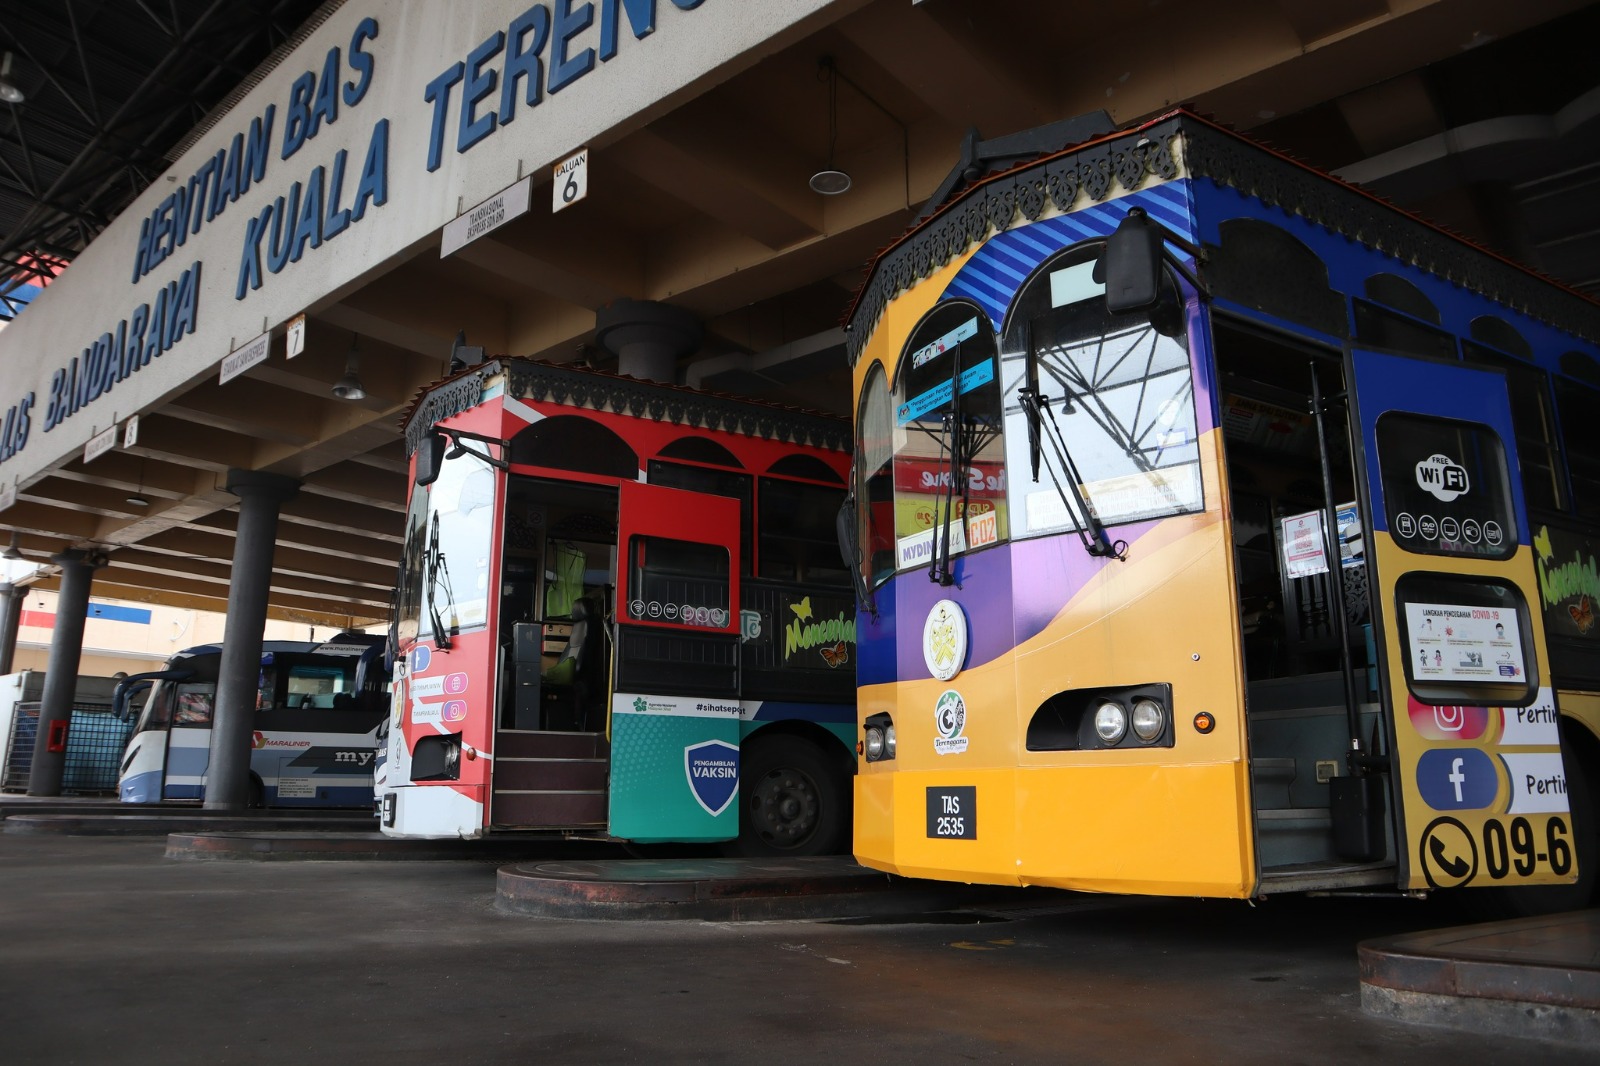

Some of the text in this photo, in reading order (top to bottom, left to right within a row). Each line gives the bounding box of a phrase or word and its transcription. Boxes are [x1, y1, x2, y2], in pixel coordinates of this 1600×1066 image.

[132, 17, 378, 284] HENTIAN BAS
[556, 154, 585, 177] LALUAN
[562, 171, 578, 203] 6
[469, 196, 504, 226] TRANSNASIONAL
[0, 391, 35, 465] LIS
[43, 260, 202, 432] BANDARAYA
[235, 118, 389, 300] KUALA
[292, 329, 300, 354] 7
[127, 426, 134, 444] 8
[1432, 457, 1449, 465] FREE
[1422, 609, 1443, 617] LANGKAH
[1443, 610, 1471, 618] PENCEGAHAN
[1472, 610, 1490, 619] COVID
[785, 611, 857, 661] Menceria
[935, 739, 967, 747] Terengganu
[335, 749, 378, 766] my
[692, 767, 736, 778] VAKSIN
[941, 795, 960, 815] TAS
[937, 817, 964, 836] 2535
[1483, 816, 1572, 879] 09-6
